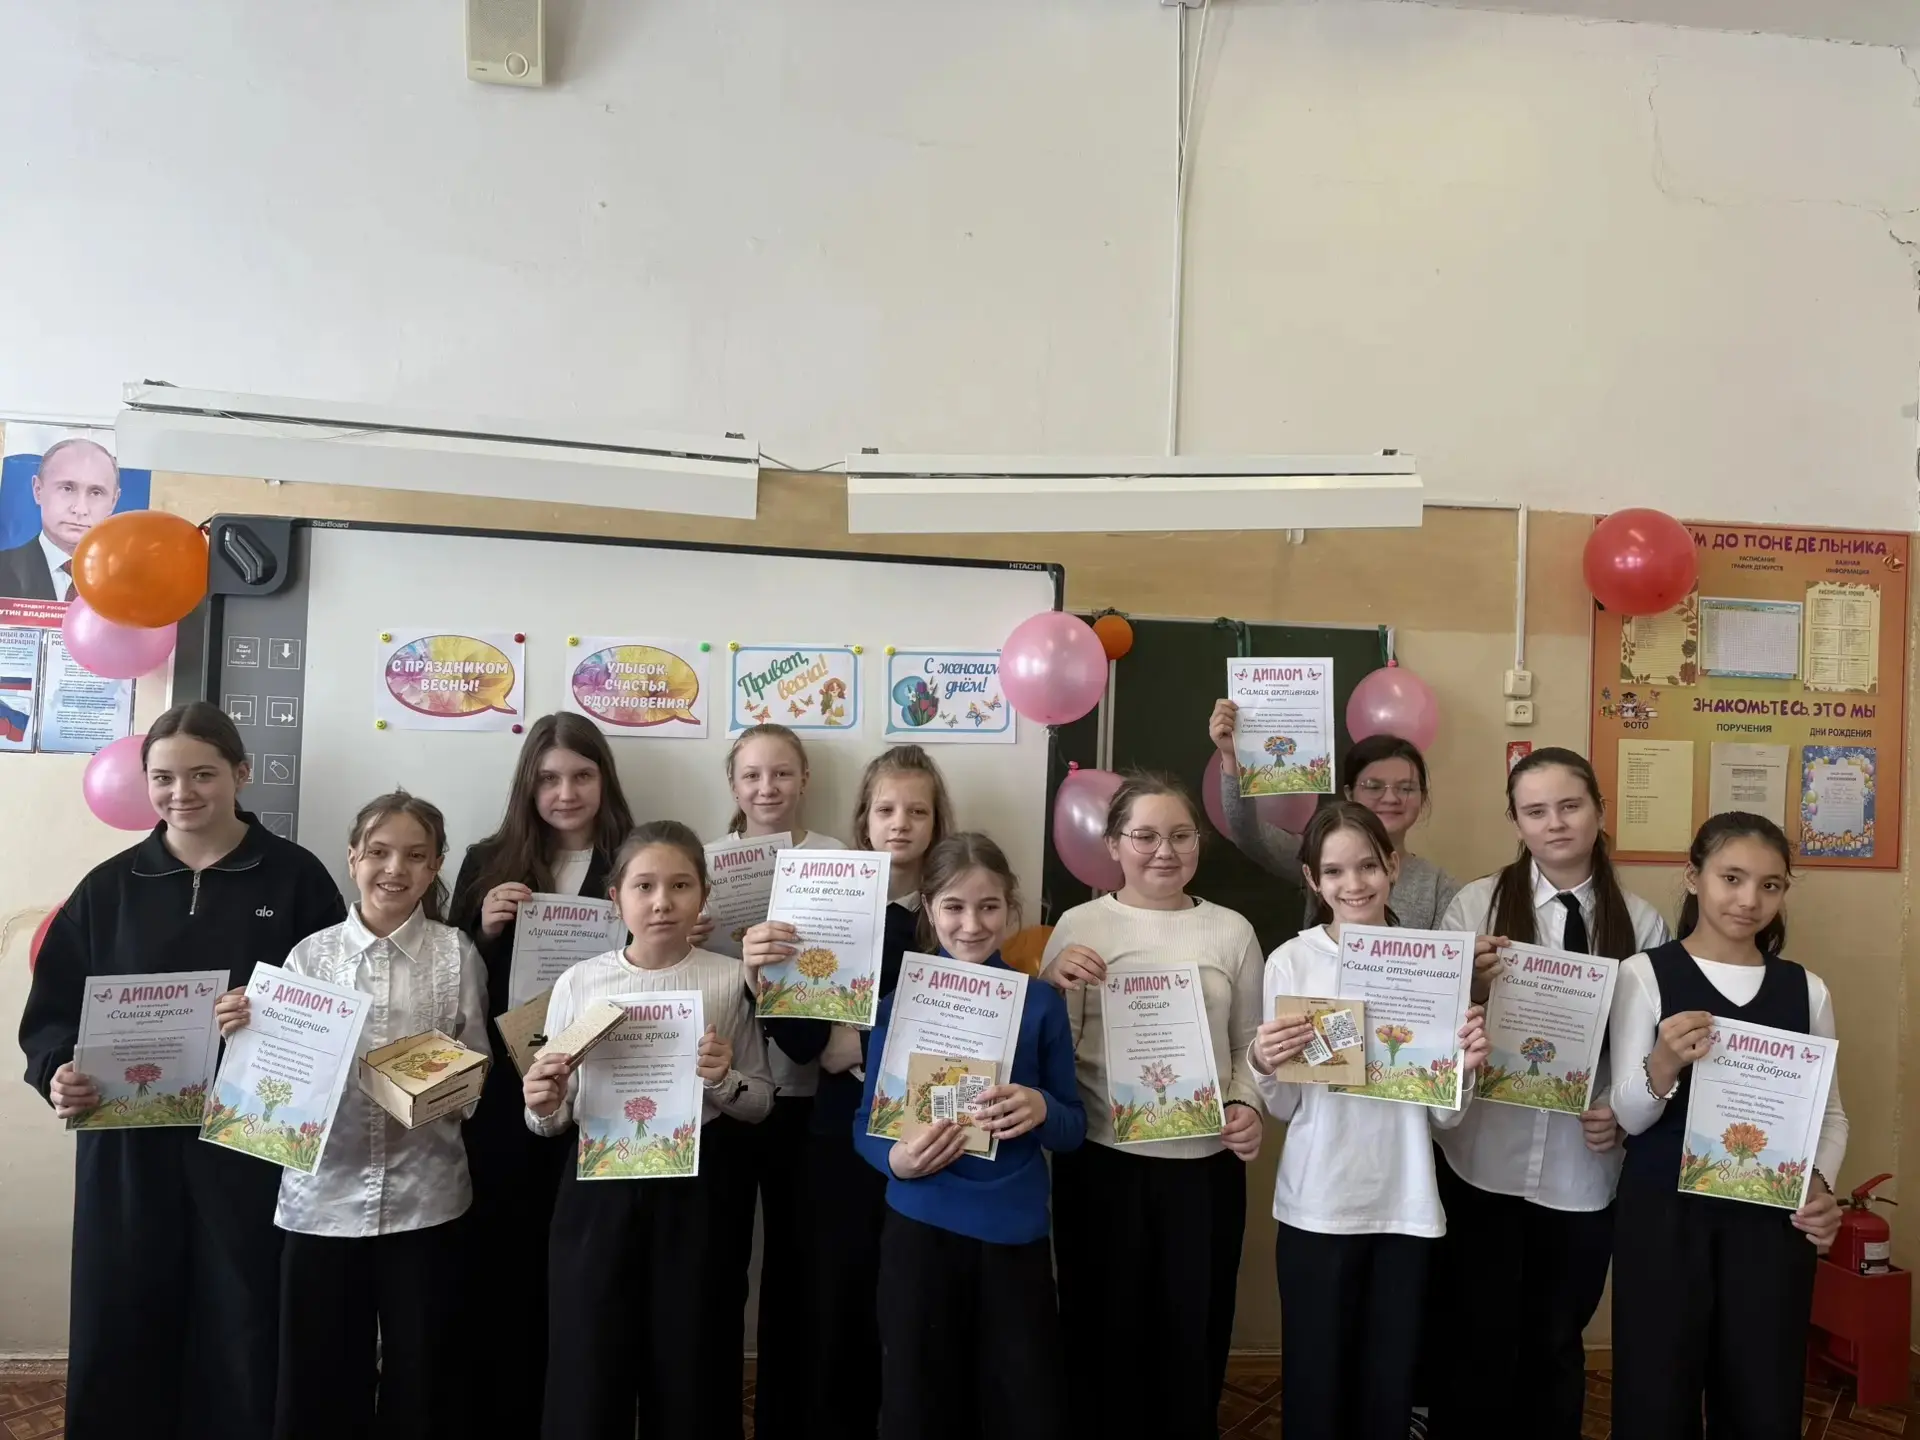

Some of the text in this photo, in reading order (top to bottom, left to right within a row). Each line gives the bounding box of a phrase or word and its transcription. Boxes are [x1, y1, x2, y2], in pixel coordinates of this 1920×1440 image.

[312, 520, 349, 528] StarBoard
[1693, 533, 1887, 556] М ДО ПОНЕДЕЛЬНИКА
[391, 660, 508, 675] С ПРАЗДНИКОМ
[606, 661, 668, 676] УЛЫБОК,
[924, 657, 934, 674] С
[737, 651, 810, 701] Привет,
[776, 653, 829, 701] весна!
[1252, 668, 1303, 682] ДИПЛОМ
[421, 677, 480, 692] ВЕСНЫ!
[604, 679, 669, 693] СЧАСТЬЯ,
[944, 676, 988, 700] днём!
[1237, 687, 1269, 695] «Самая
[583, 695, 690, 709] ВДОХНОВЕНИЯ!
[1813, 702, 1847, 718] ЭТО
[1850, 703, 1876, 719] МЫ
[1623, 721, 1649, 730] ФОТО
[1716, 723, 1772, 733] ПОРУЧЕНИЯ
[1809, 728, 1872, 738] ДНИ РОЖДЕНИЯ
[714, 847, 765, 871] ДИПЛОМ
[800, 862, 855, 878] ДИПЛОМ
[786, 884, 865, 897] «Самая веселая»
[255, 905, 274, 917] alo
[542, 905, 598, 922] ДИПЛОМ
[528, 927, 608, 939] «Лучшая певица»
[1370, 939, 1436, 958] ДИПЛОМ
[1342, 960, 1460, 979] «Самая отзывчивая»
[1523, 956, 1582, 979] ДИПЛОМ
[929, 970, 990, 997] ДИПЛОМ
[1124, 975, 1171, 995] ДИПЛОМ
[1503, 974, 1596, 999] «Самая активная»
[119, 984, 189, 1004] ДИПЛОМ
[272, 984, 333, 1014] ДИПЛОМ
[107, 1007, 194, 1020] «Самая яркая»
[623, 1004, 673, 1021] ИПЛОМ
[912, 993, 999, 1019] «Самая веселая»
[1128, 1000, 1170, 1010] «Обаяние»
[262, 1006, 330, 1034] «Восхищение»
[645, 1030, 679, 1044] яркая»
[1727, 1032, 1795, 1060] ДИПЛОМ
[1713, 1056, 1802, 1080] «Самая добрая»
